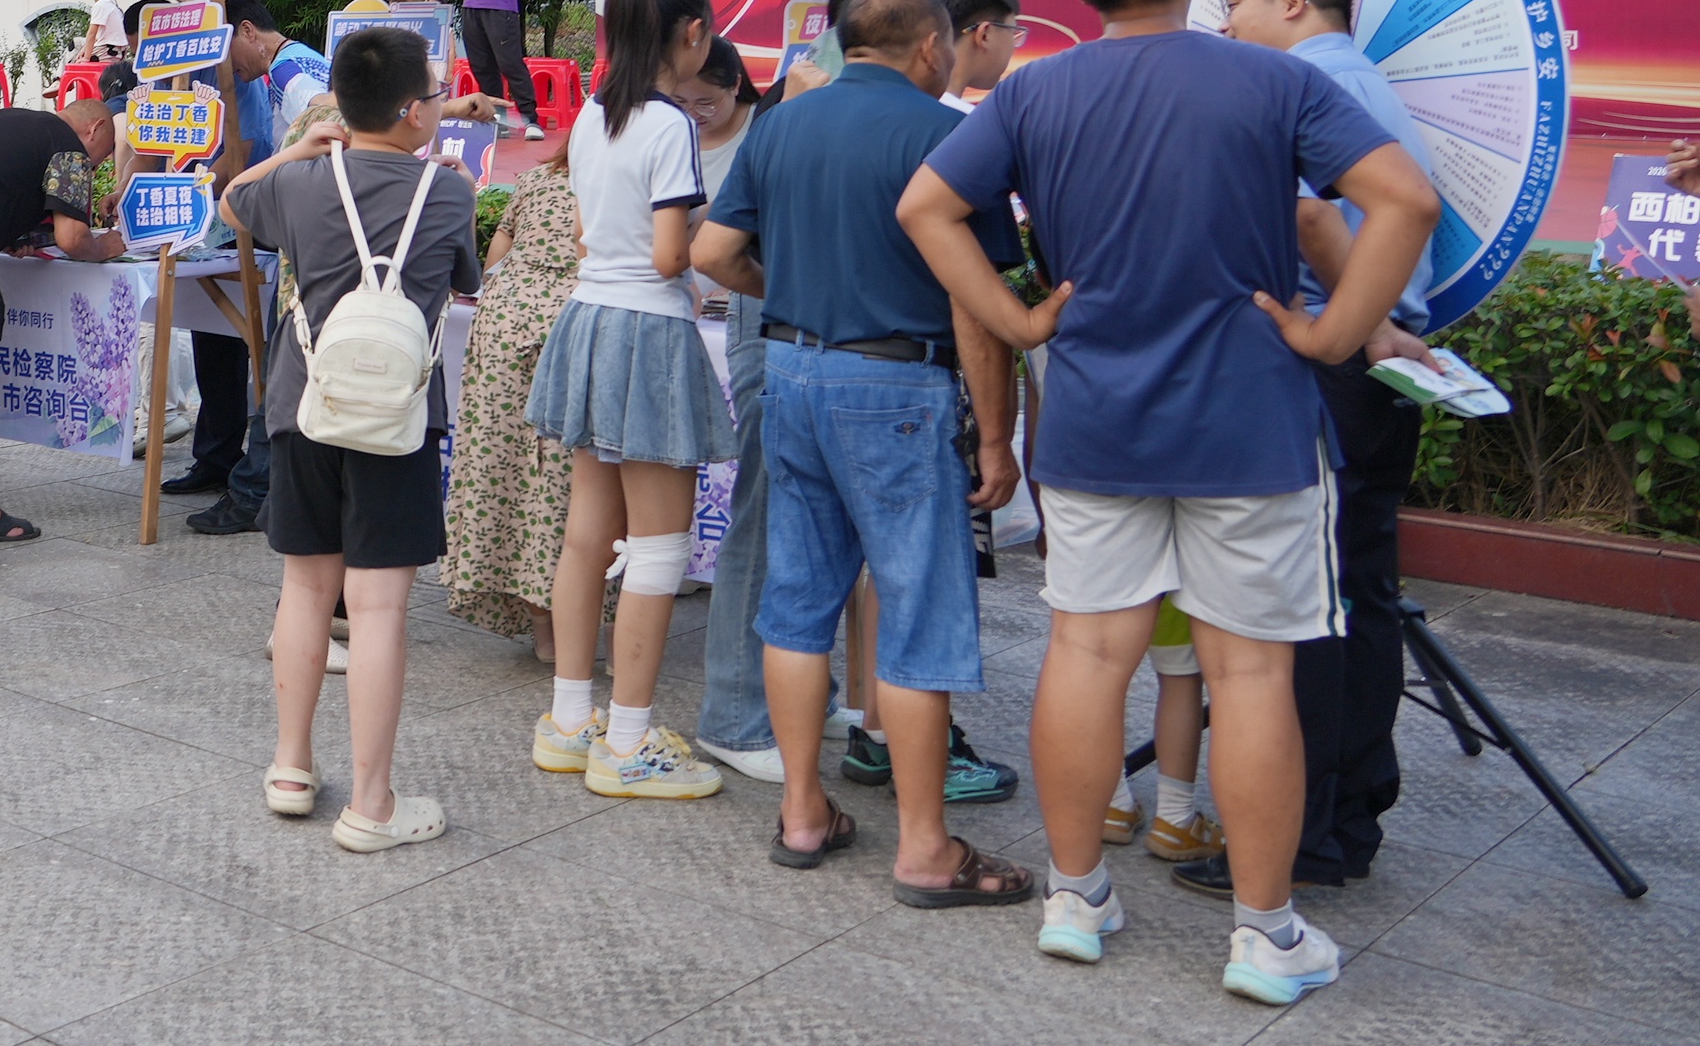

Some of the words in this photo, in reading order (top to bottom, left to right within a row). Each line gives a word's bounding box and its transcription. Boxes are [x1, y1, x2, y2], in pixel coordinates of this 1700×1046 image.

[143, 36, 223, 63] 检护丁香百姓安
[138, 102, 208, 122] 法治丁香
[138, 126, 207, 146] 你我共建
[135, 185, 194, 206] 丁香夏夜
[135, 206, 194, 227] 法治相伴
[1648, 228, 1700, 263] 代
[6, 308, 54, 329] 伴你同行
